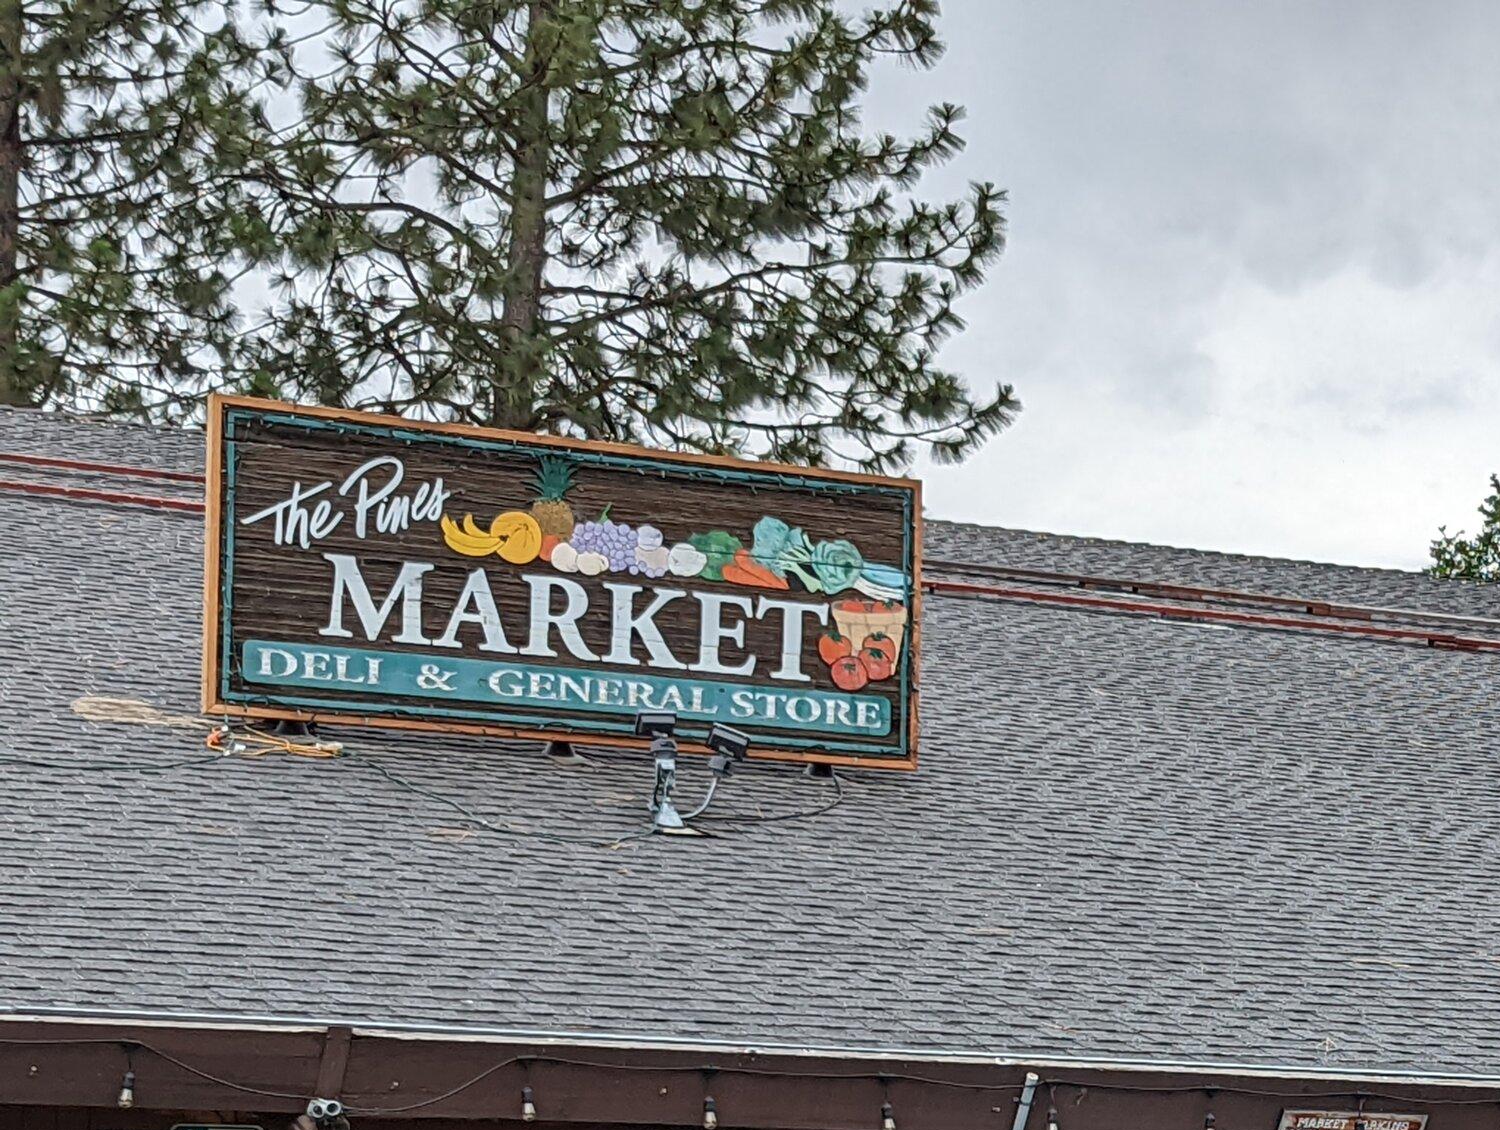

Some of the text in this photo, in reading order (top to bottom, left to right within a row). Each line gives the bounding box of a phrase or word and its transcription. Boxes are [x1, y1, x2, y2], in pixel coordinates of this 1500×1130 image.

[241, 456, 451, 549] The Pines
[318, 553, 830, 682] MARKET
[256, 647, 883, 729] DELI & GENERAL STORE
[1297, 1117, 1349, 1130] MARKET
